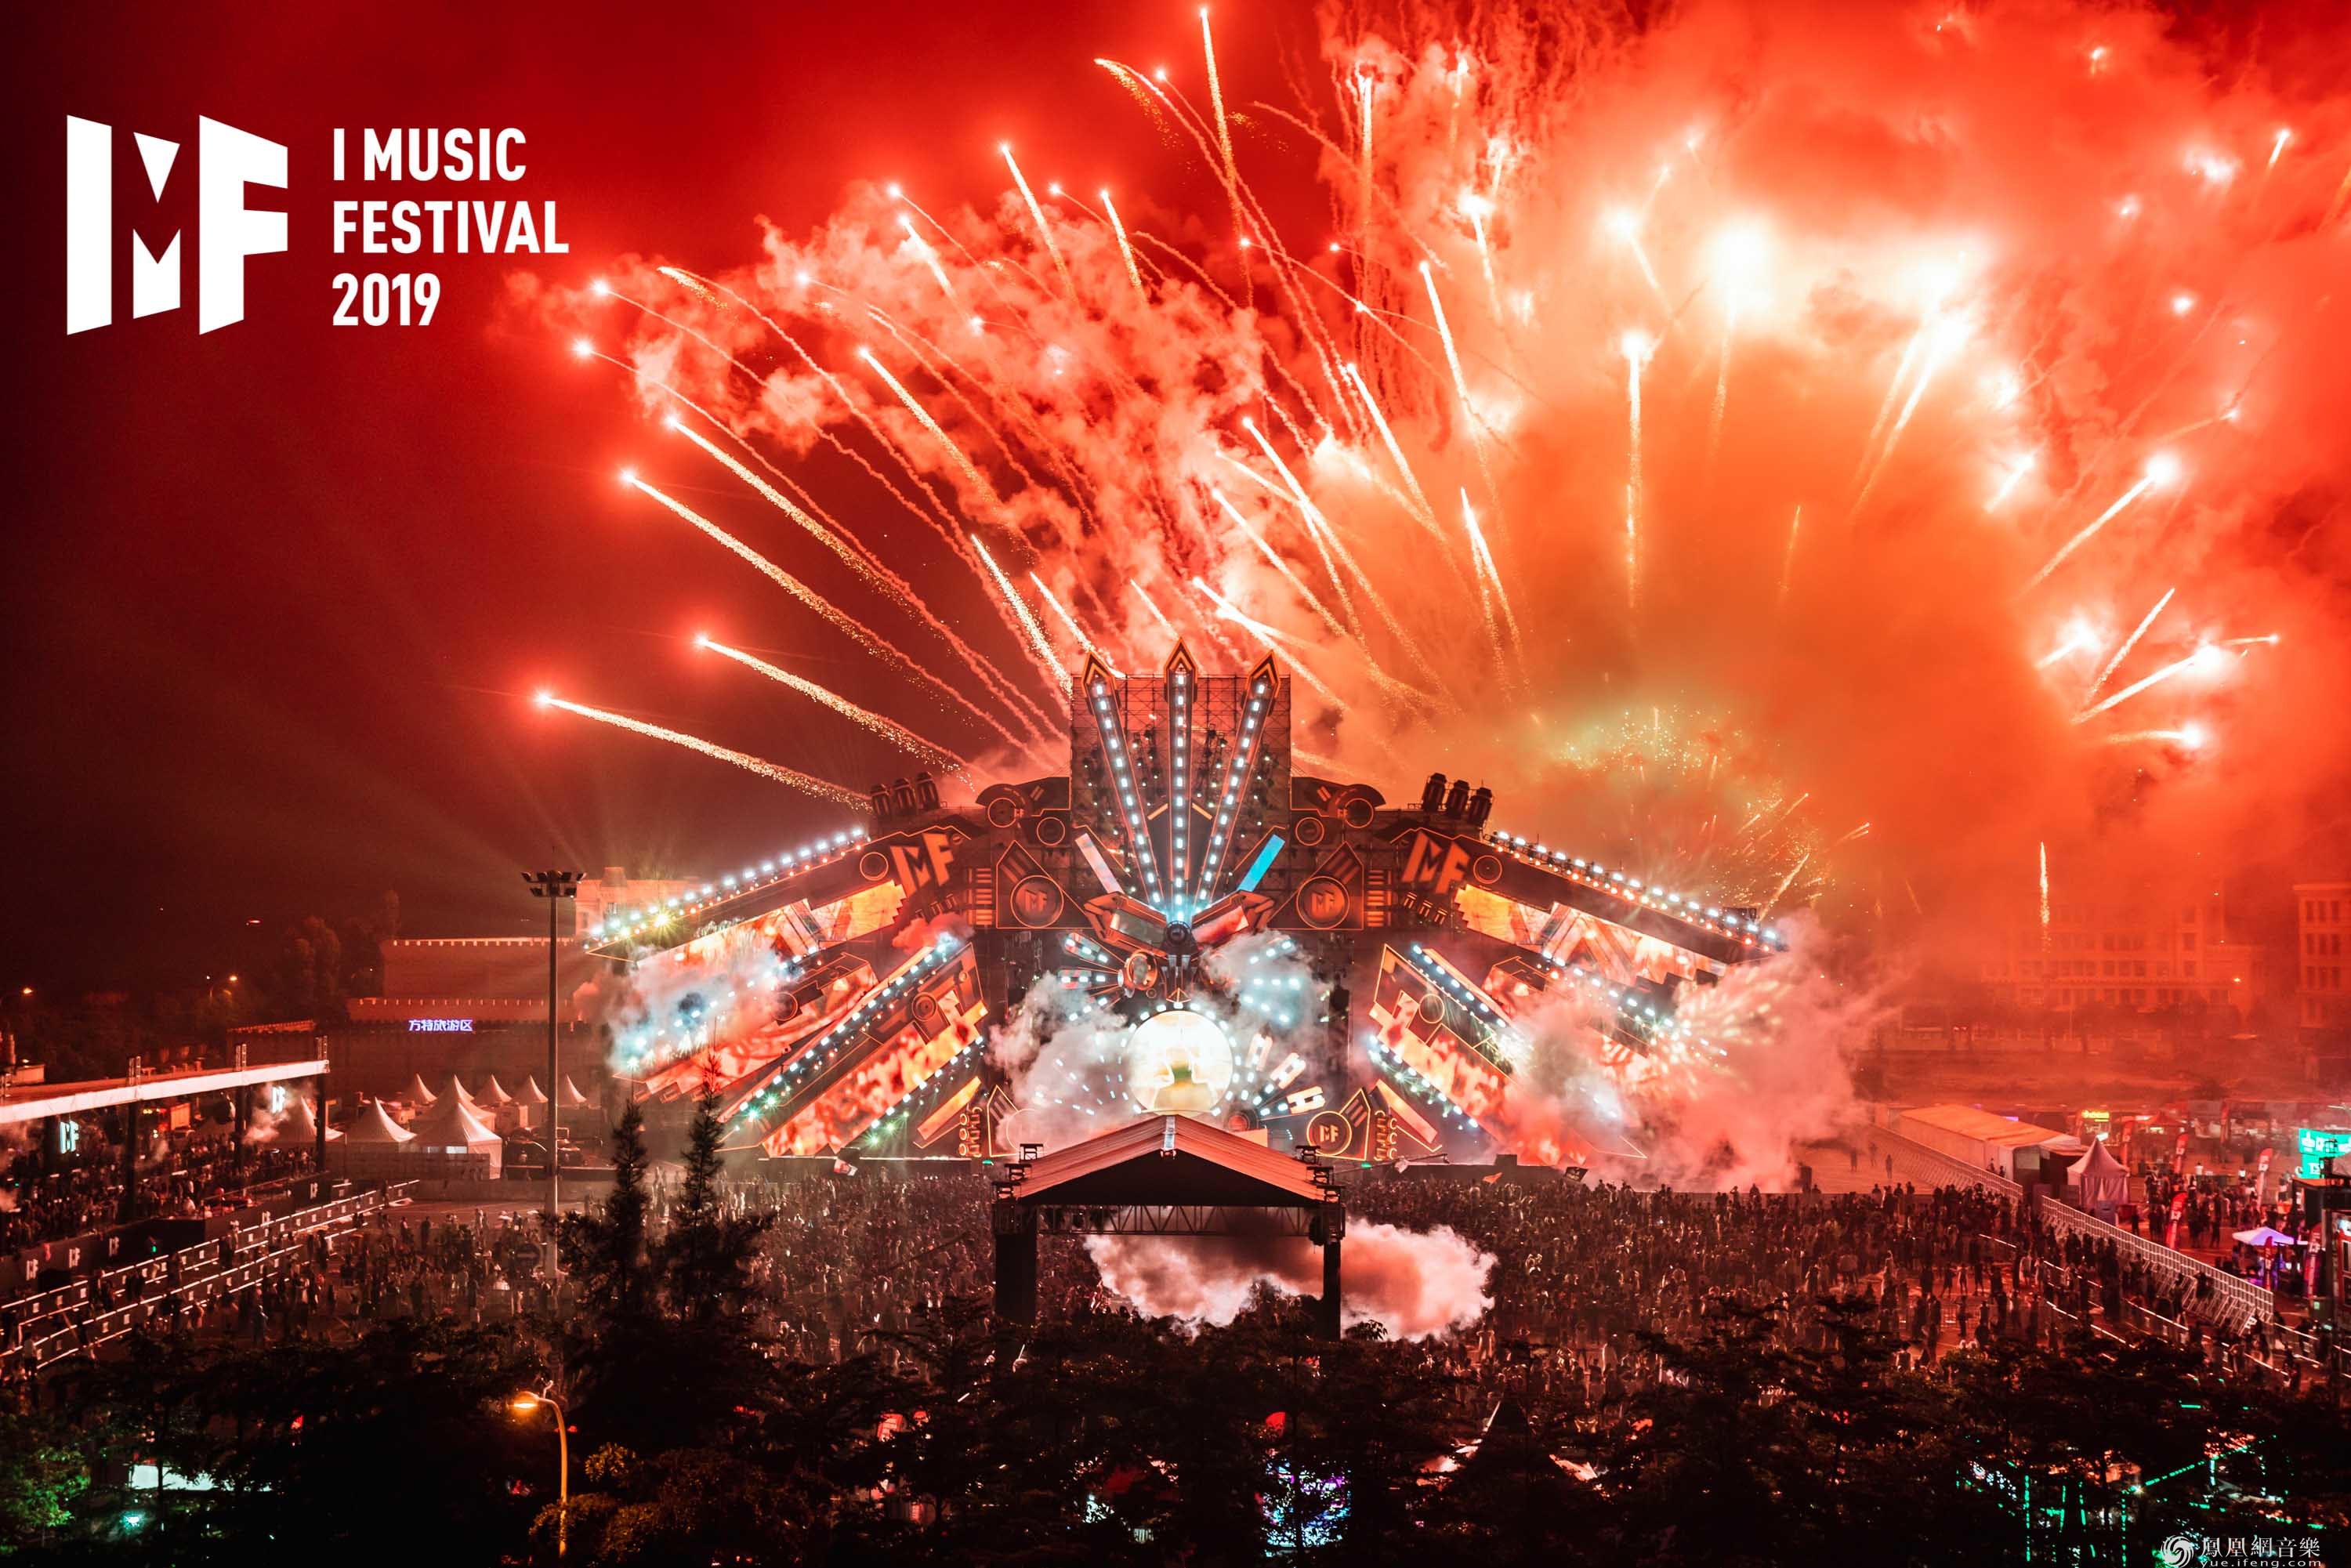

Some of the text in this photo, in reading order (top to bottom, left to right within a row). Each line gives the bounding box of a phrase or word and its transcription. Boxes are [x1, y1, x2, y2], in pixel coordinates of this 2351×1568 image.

[408, 1019, 473, 1032] 方特旅游区
